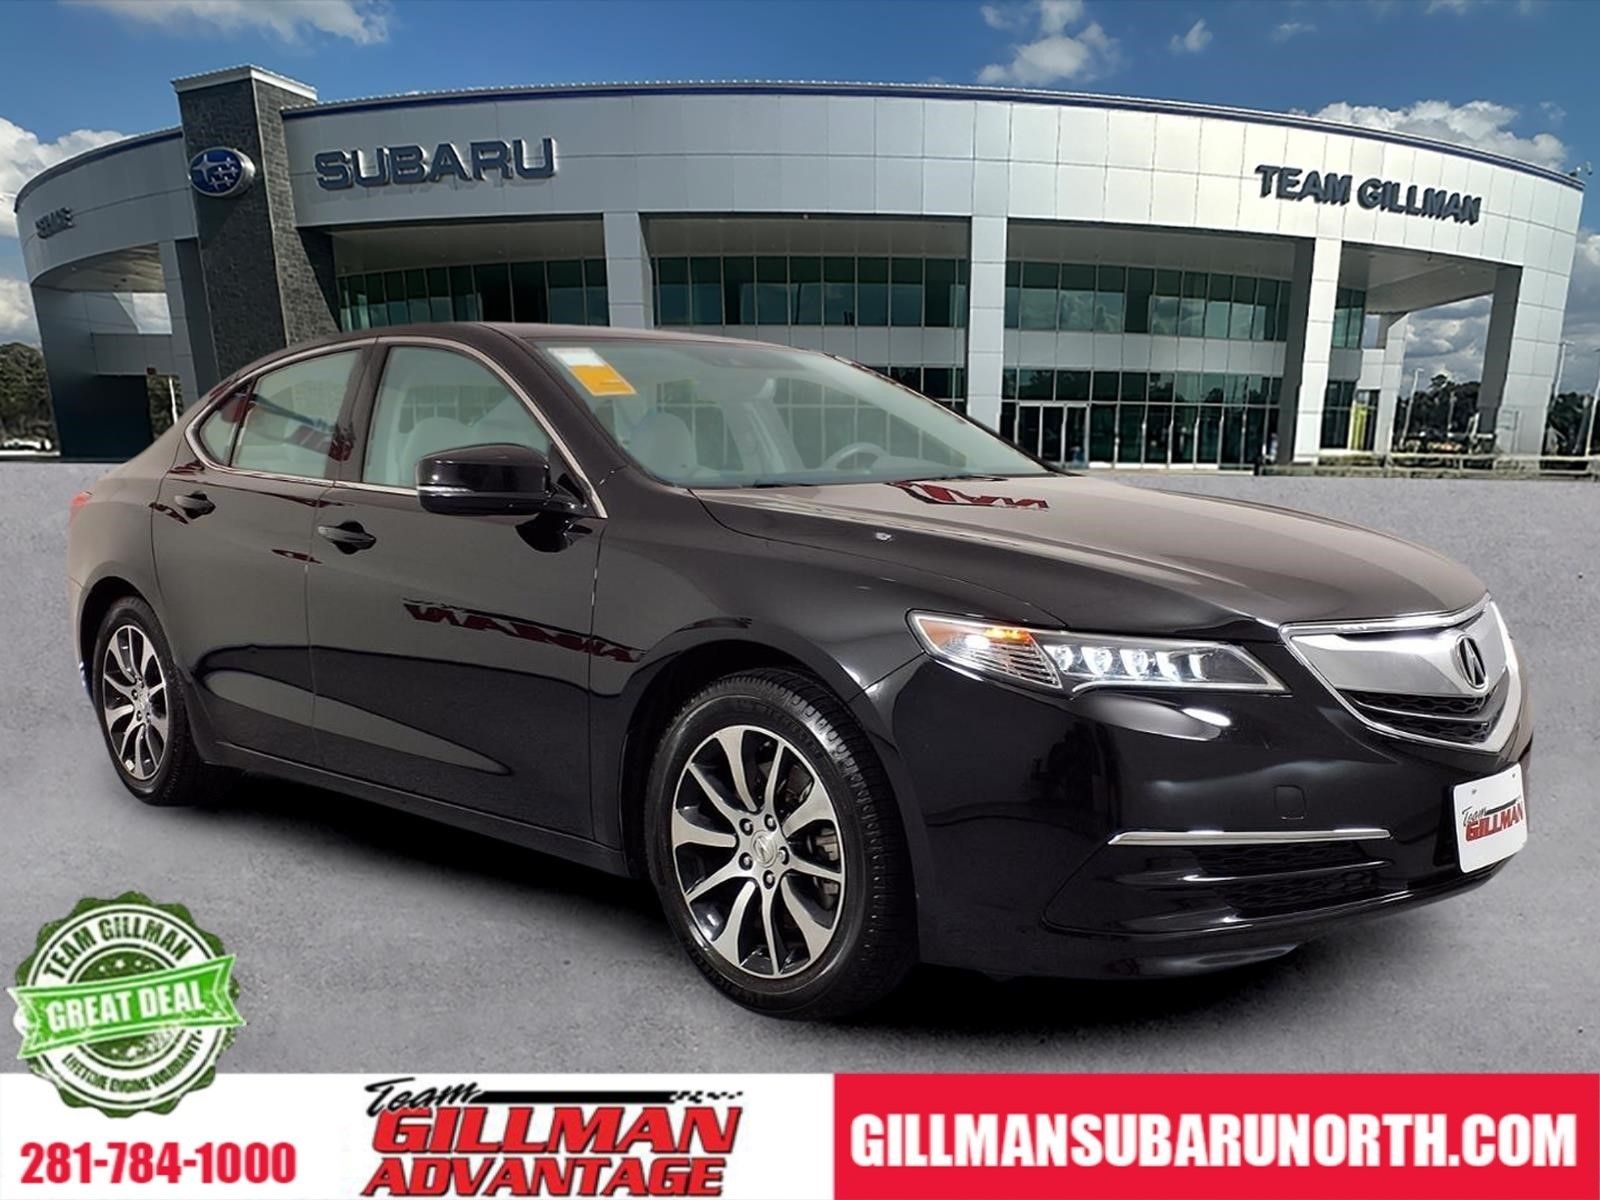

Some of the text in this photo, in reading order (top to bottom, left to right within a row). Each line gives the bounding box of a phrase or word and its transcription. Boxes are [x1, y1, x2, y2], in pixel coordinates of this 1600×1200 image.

[314, 137, 557, 191] SUBARU
[1255, 165, 1482, 225] TEAM GILLMAN
[1462, 807, 1486, 826] Team
[1466, 802, 1524, 841] GILLMAN
